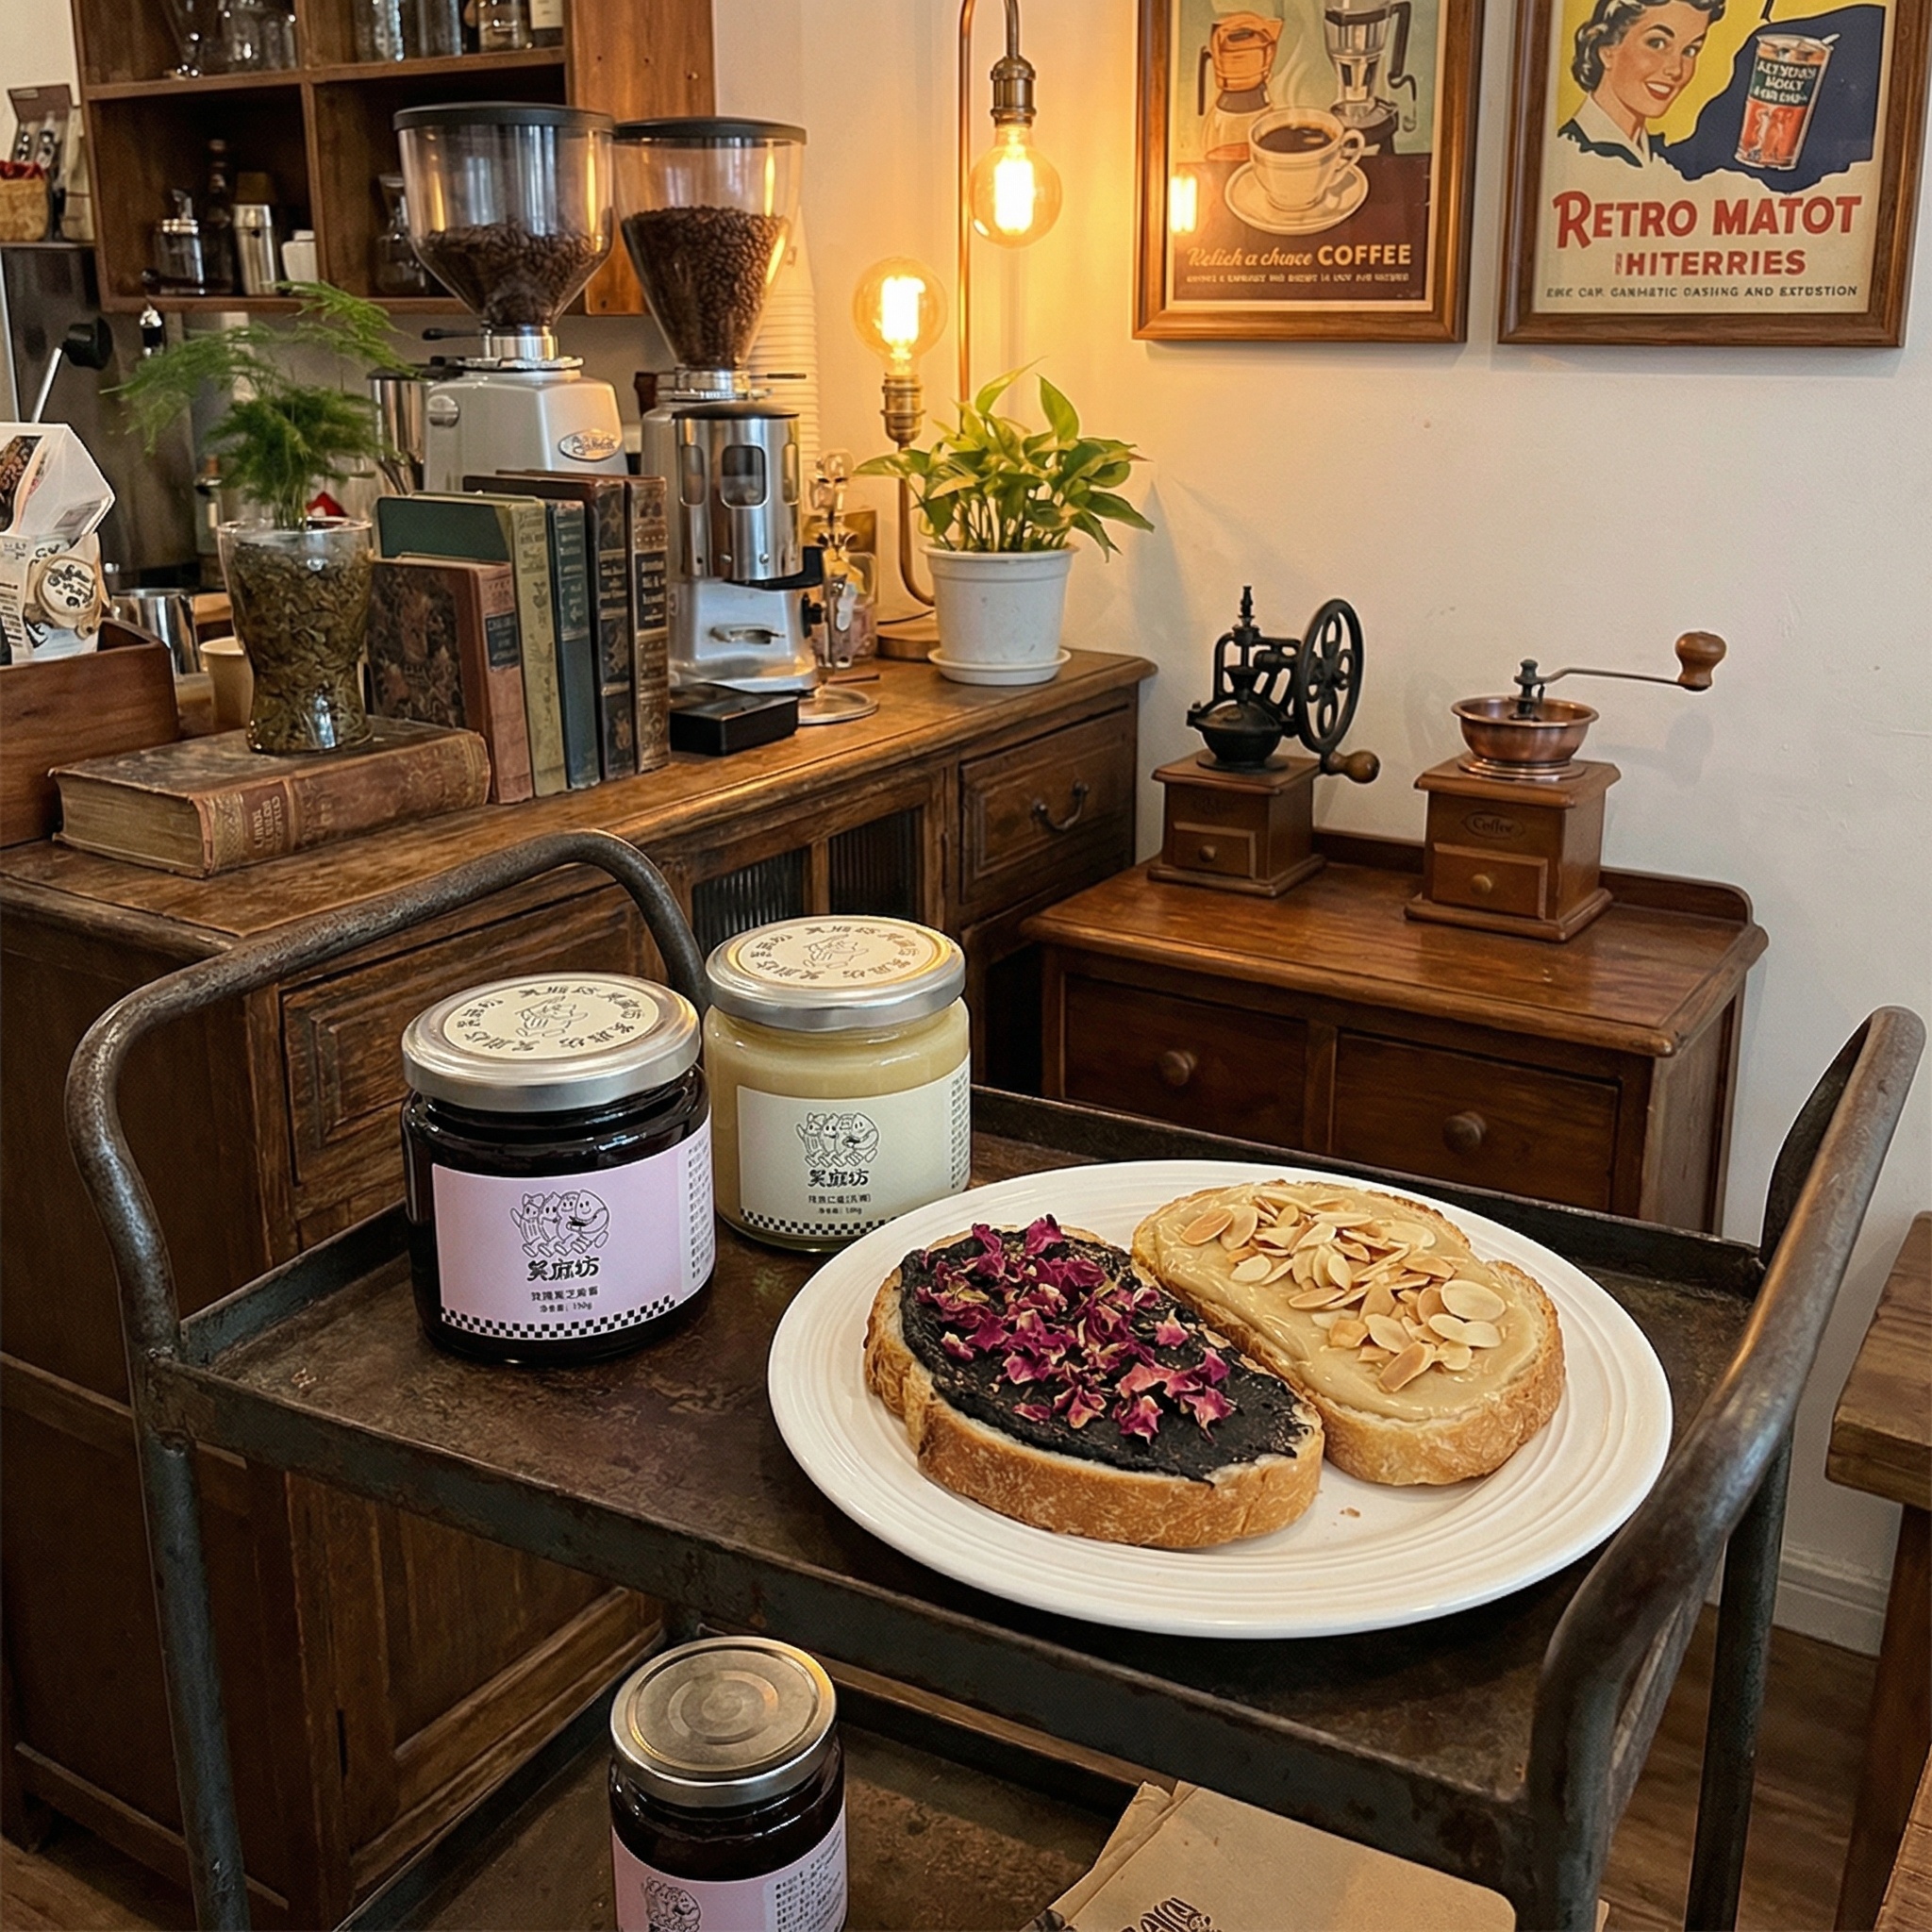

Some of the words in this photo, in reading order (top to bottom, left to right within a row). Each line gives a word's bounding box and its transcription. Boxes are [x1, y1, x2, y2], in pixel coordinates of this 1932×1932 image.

[1552, 191, 1698, 249] RETRO
[1712, 195, 1862, 236] MATOT
[1318, 244, 1411, 266] COFFEE
[1744, 287, 1774, 297] AND
